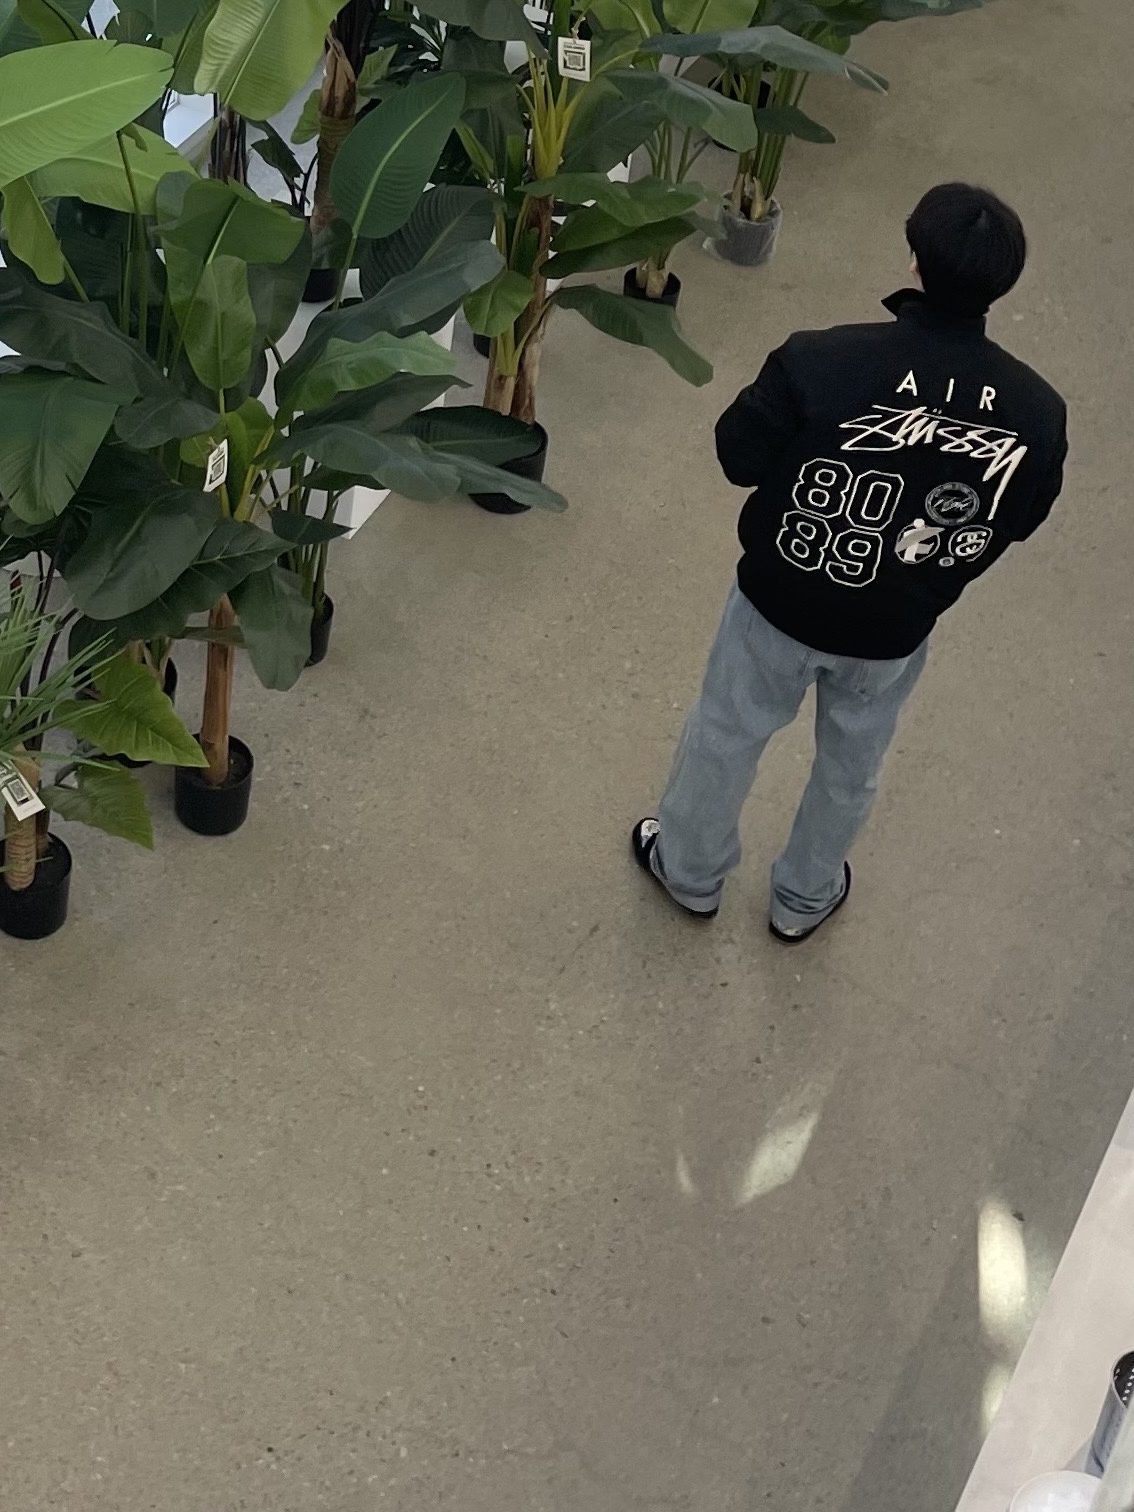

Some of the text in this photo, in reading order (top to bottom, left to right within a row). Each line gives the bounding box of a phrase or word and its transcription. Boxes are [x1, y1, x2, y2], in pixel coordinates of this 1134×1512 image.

[895, 369, 997, 411] AIR
[792, 457, 905, 531] 80
[776, 510, 883, 587] 89
